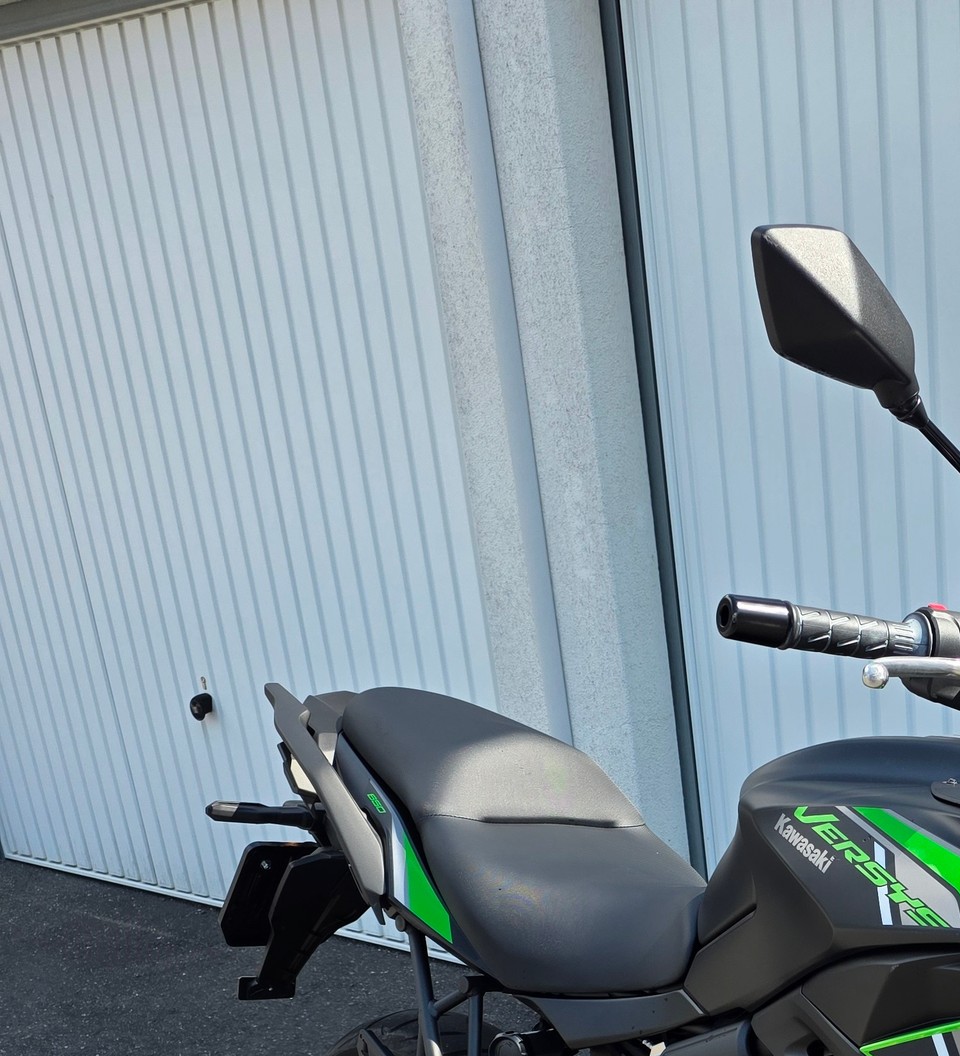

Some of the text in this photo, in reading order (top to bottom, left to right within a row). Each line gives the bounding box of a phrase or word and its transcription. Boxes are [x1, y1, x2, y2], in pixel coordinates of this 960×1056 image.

[367, 793, 387, 814] 650
[773, 812, 837, 875] Kawasaki
[793, 805, 951, 928] VERSYS
